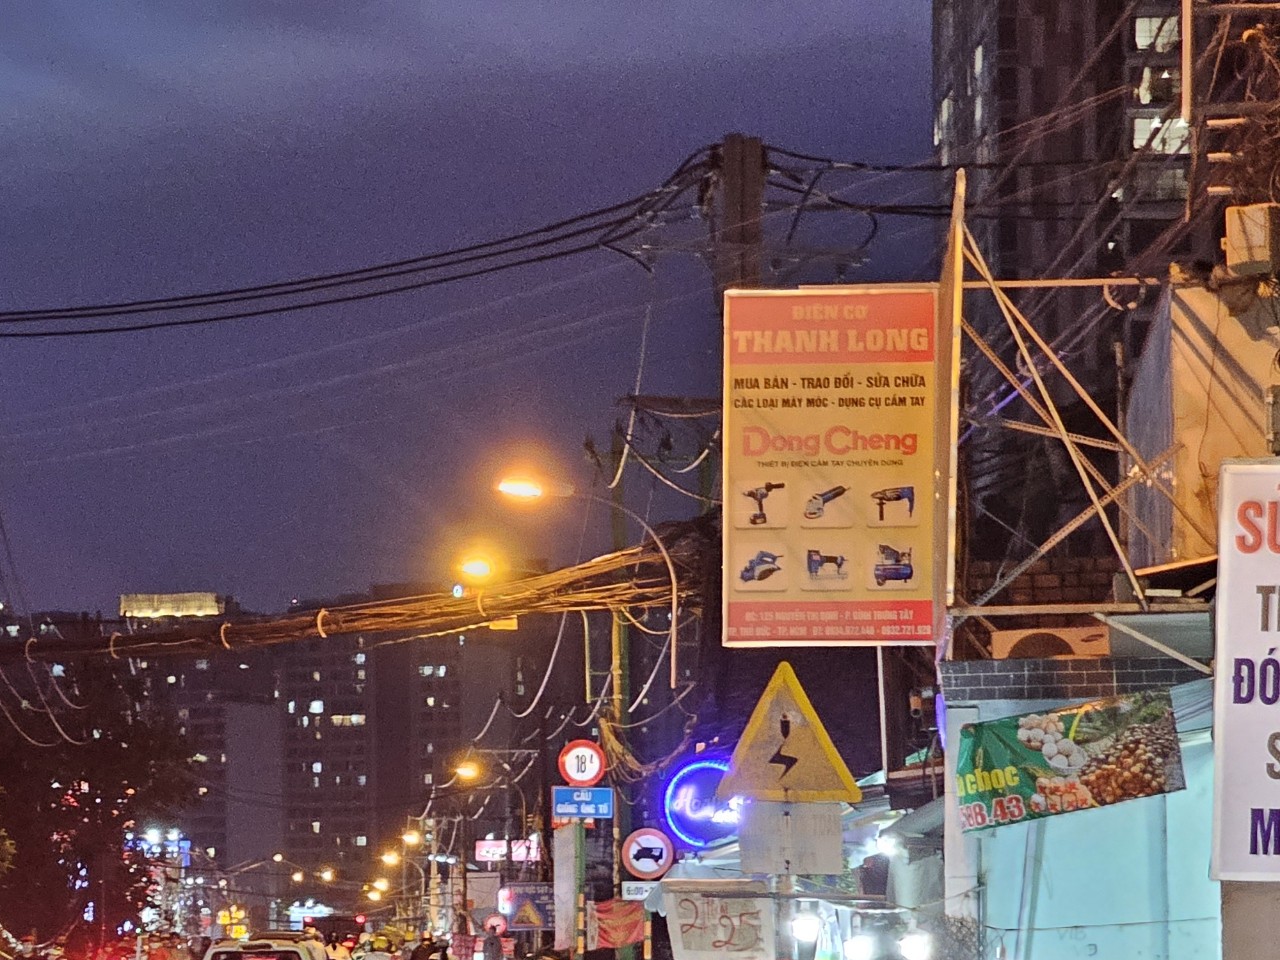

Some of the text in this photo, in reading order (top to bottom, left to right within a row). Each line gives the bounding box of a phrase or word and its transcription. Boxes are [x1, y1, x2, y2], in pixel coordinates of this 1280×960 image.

[733, 328, 930, 353] THANH LONG
[733, 377, 761, 390] MUA
[763, 374, 789, 389] BÁN
[800, 377, 830, 389] TRAO
[866, 372, 891, 389] SỬA
[893, 372, 927, 388] CHỮA
[733, 395, 755, 409] CÁC
[756, 398, 779, 412] LOẠI
[910, 396, 926, 408] TAY
[824, 425, 918, 457] Cheng
